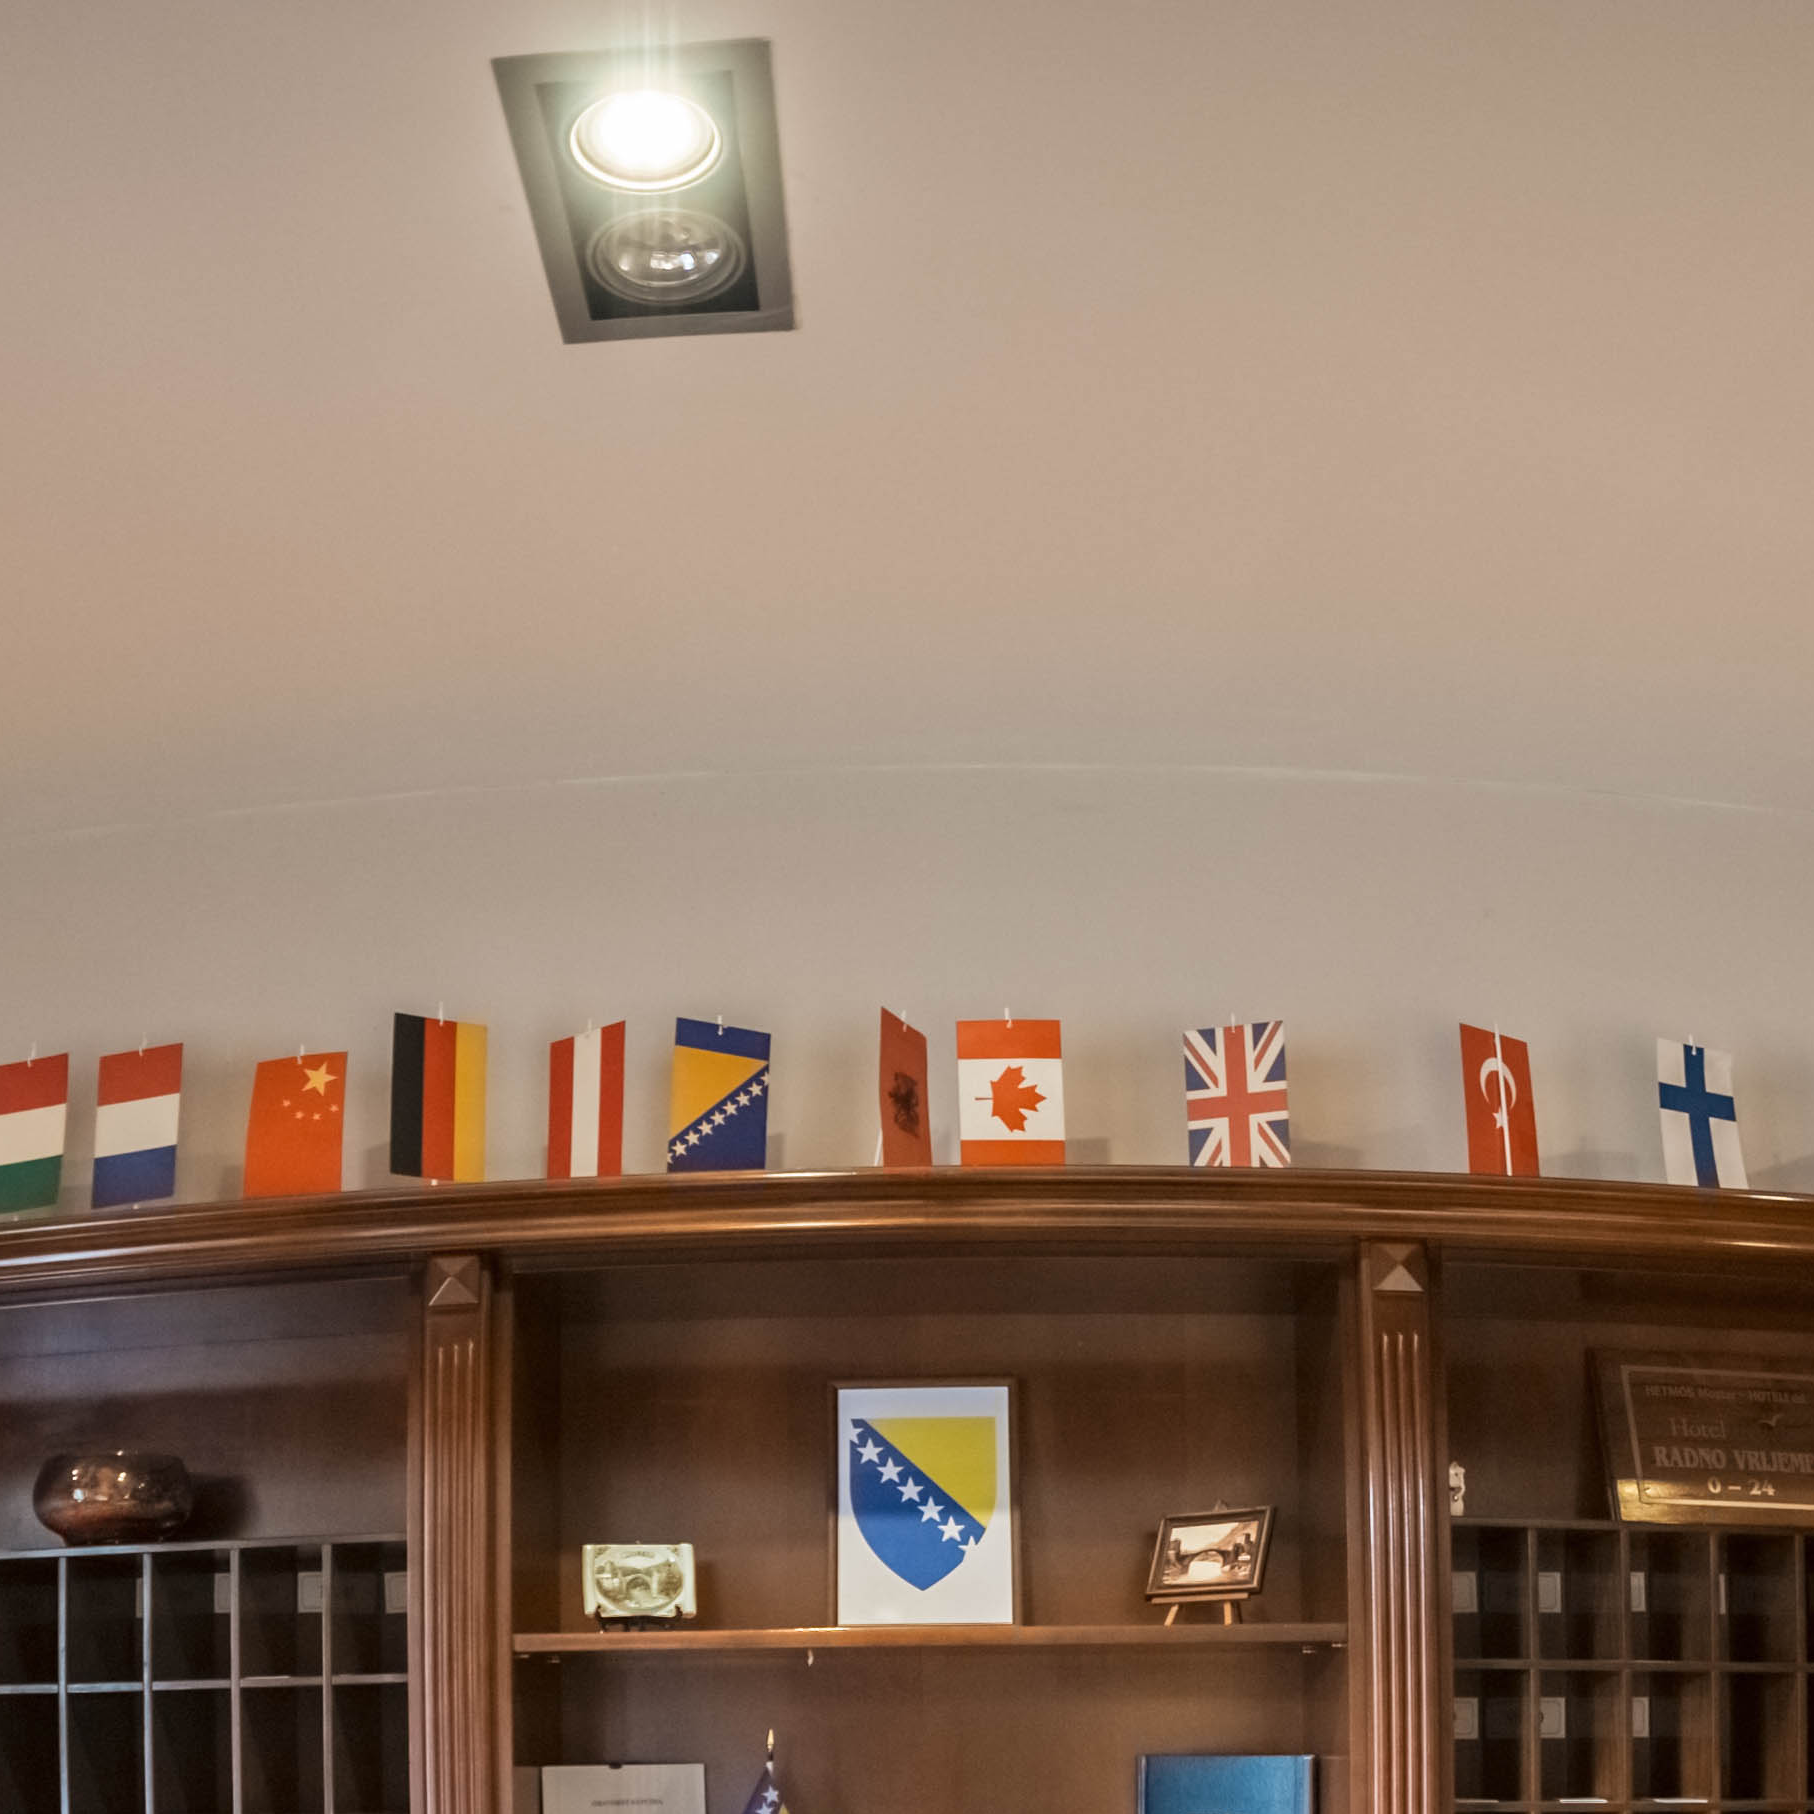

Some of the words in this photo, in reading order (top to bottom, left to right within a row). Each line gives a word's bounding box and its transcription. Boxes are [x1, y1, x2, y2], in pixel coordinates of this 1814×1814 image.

[1669, 1415, 1727, 1440] Hotel
[1652, 1446, 1727, 1470] RADNO
[1707, 1475, 1722, 1495] 0
[1748, 1478, 1775, 1497] 24
